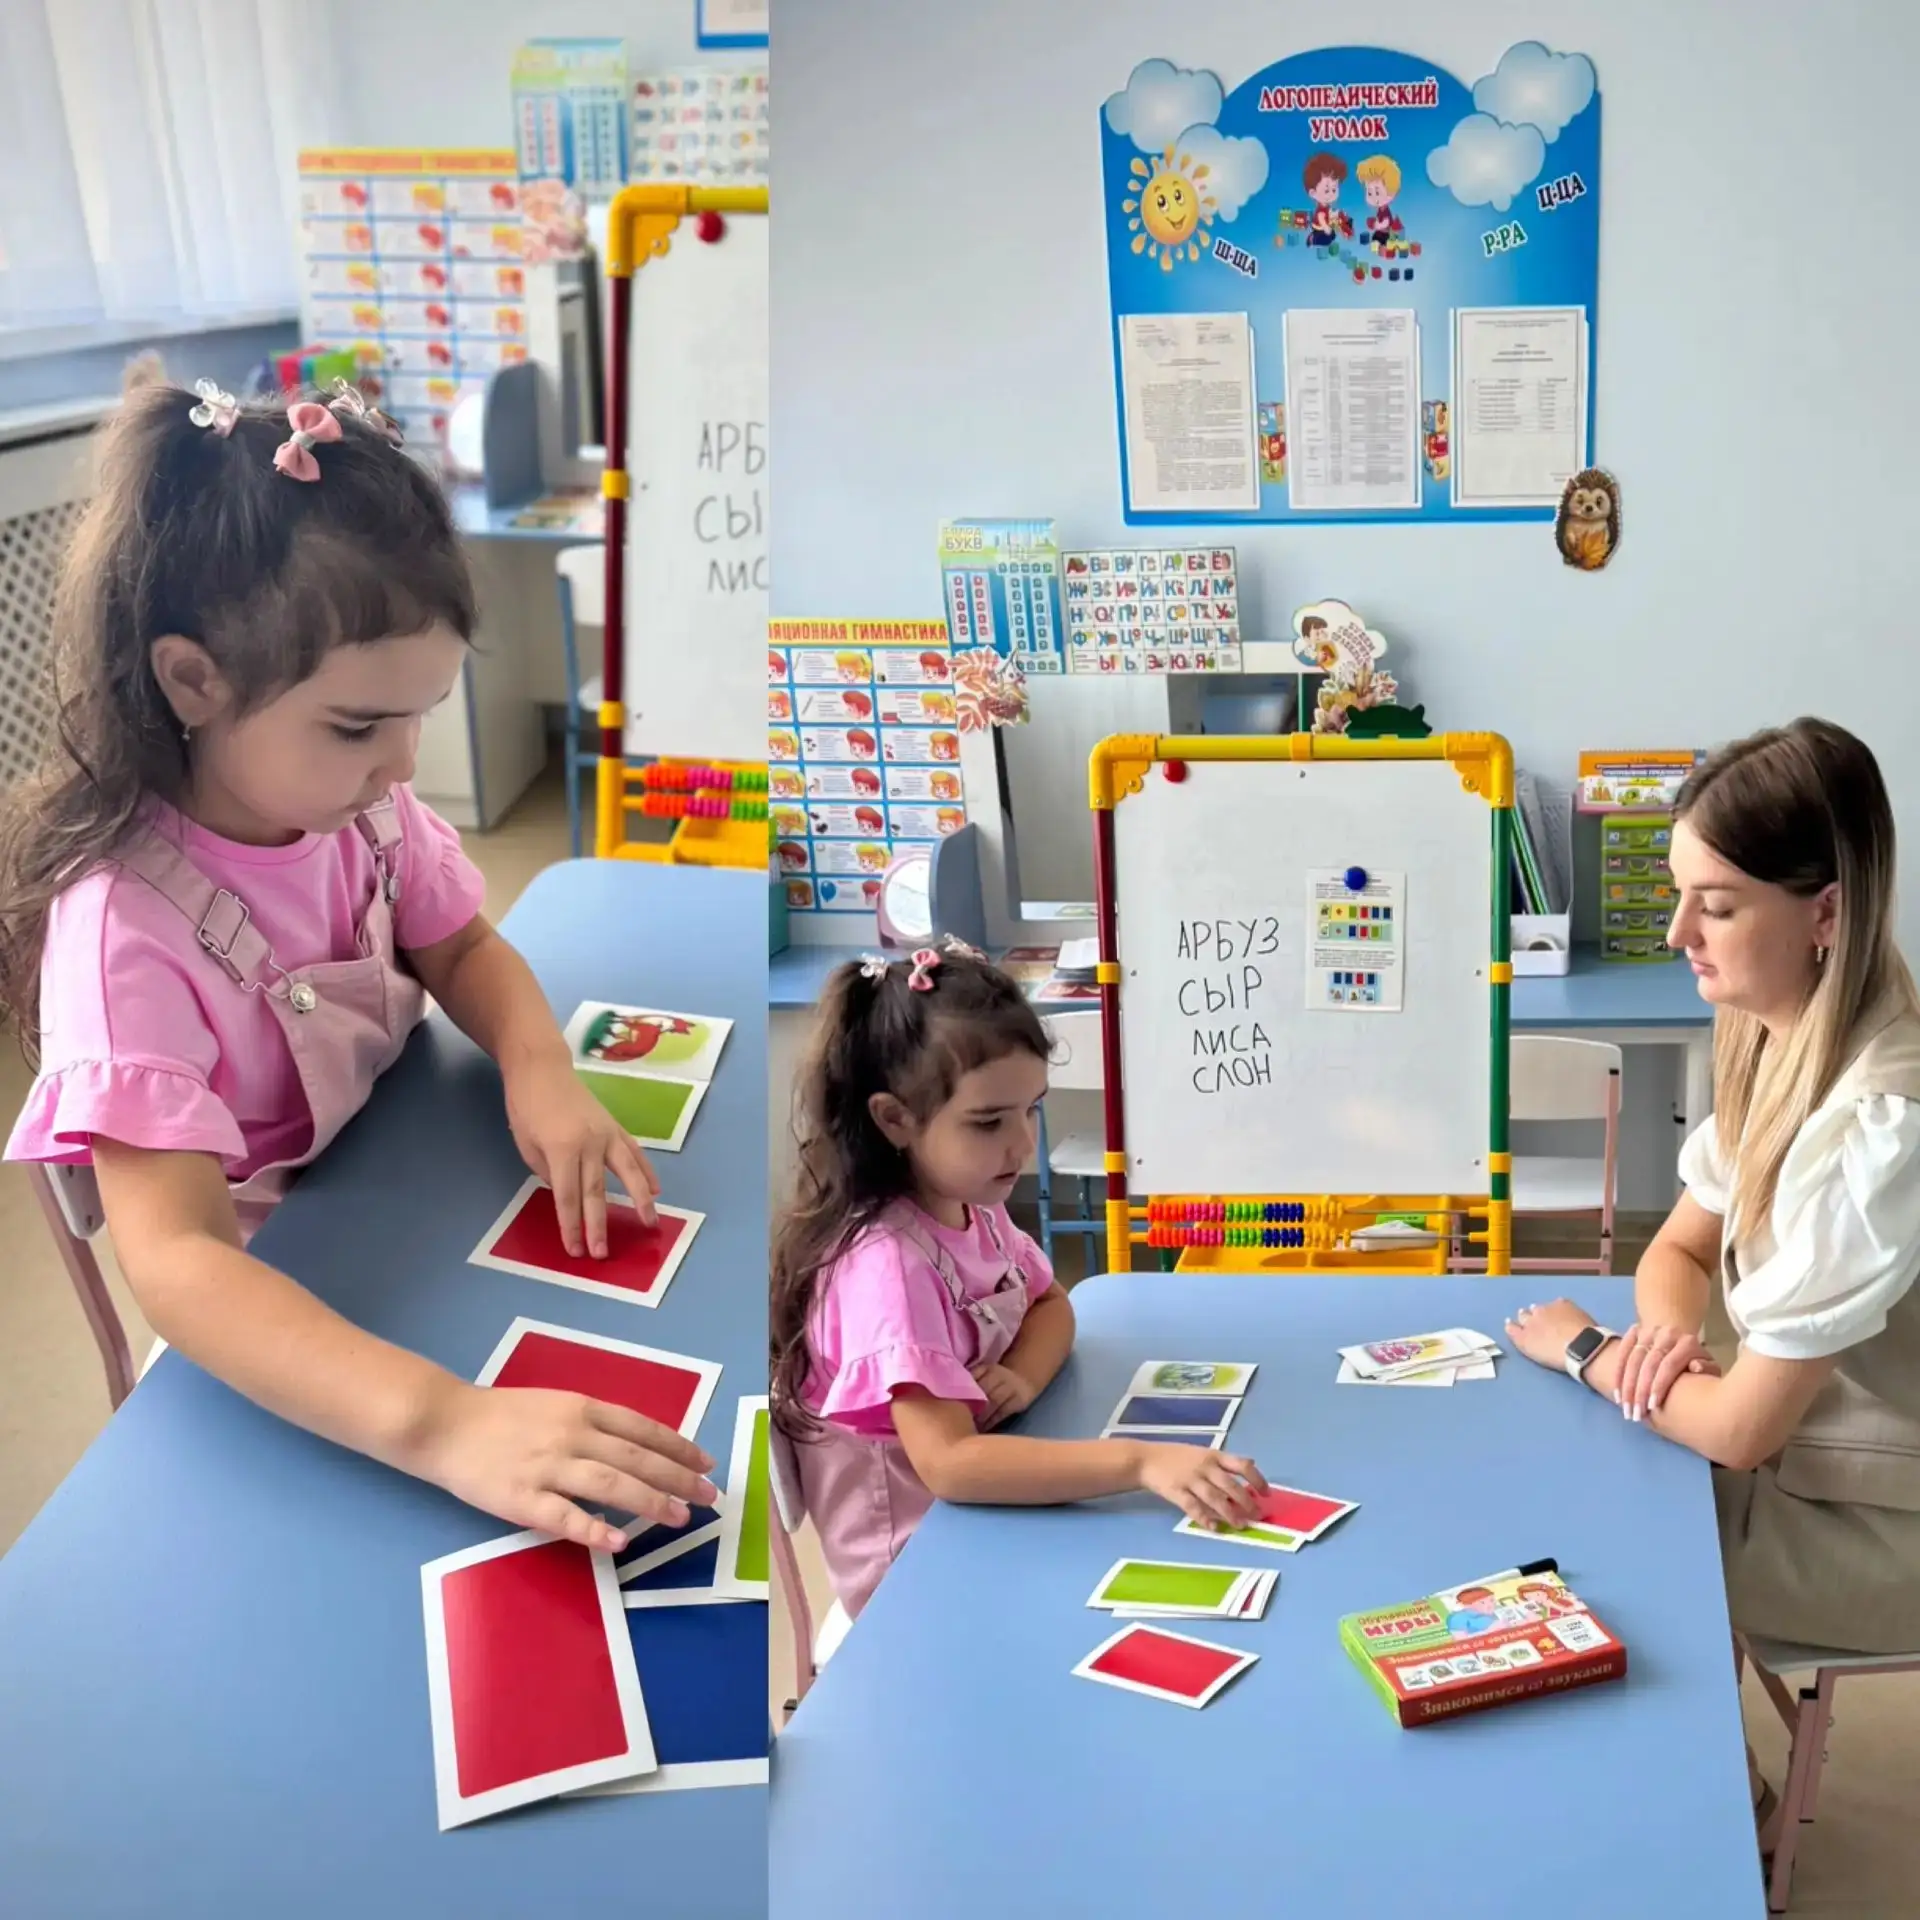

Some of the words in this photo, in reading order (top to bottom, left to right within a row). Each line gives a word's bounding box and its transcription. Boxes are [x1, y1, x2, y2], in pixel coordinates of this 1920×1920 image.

[1260, 78, 1437, 110] ЛОГОПЕДИЧЕСКИЙ
[1310, 116, 1388, 140] УГОЛОК
[1537, 174, 1585, 208] Ц-ЦА
[1483, 222, 1526, 254] Р-РА
[945, 535, 983, 550] БУКВ
[769, 622, 847, 641] ЯЦИОННАЯ
[852, 622, 947, 641] ГИМНАСТИКА
[1177, 916, 1279, 962] АРБУЗ
[1177, 964, 1262, 1017] СЫР
[1193, 1022, 1272, 1056] ЛИСА
[1192, 1053, 1272, 1094] СЛОН
[1363, 1611, 1442, 1638] игры
[1419, 1681, 1525, 1717] Знакомимся
[1546, 1662, 1613, 1689] звуками
